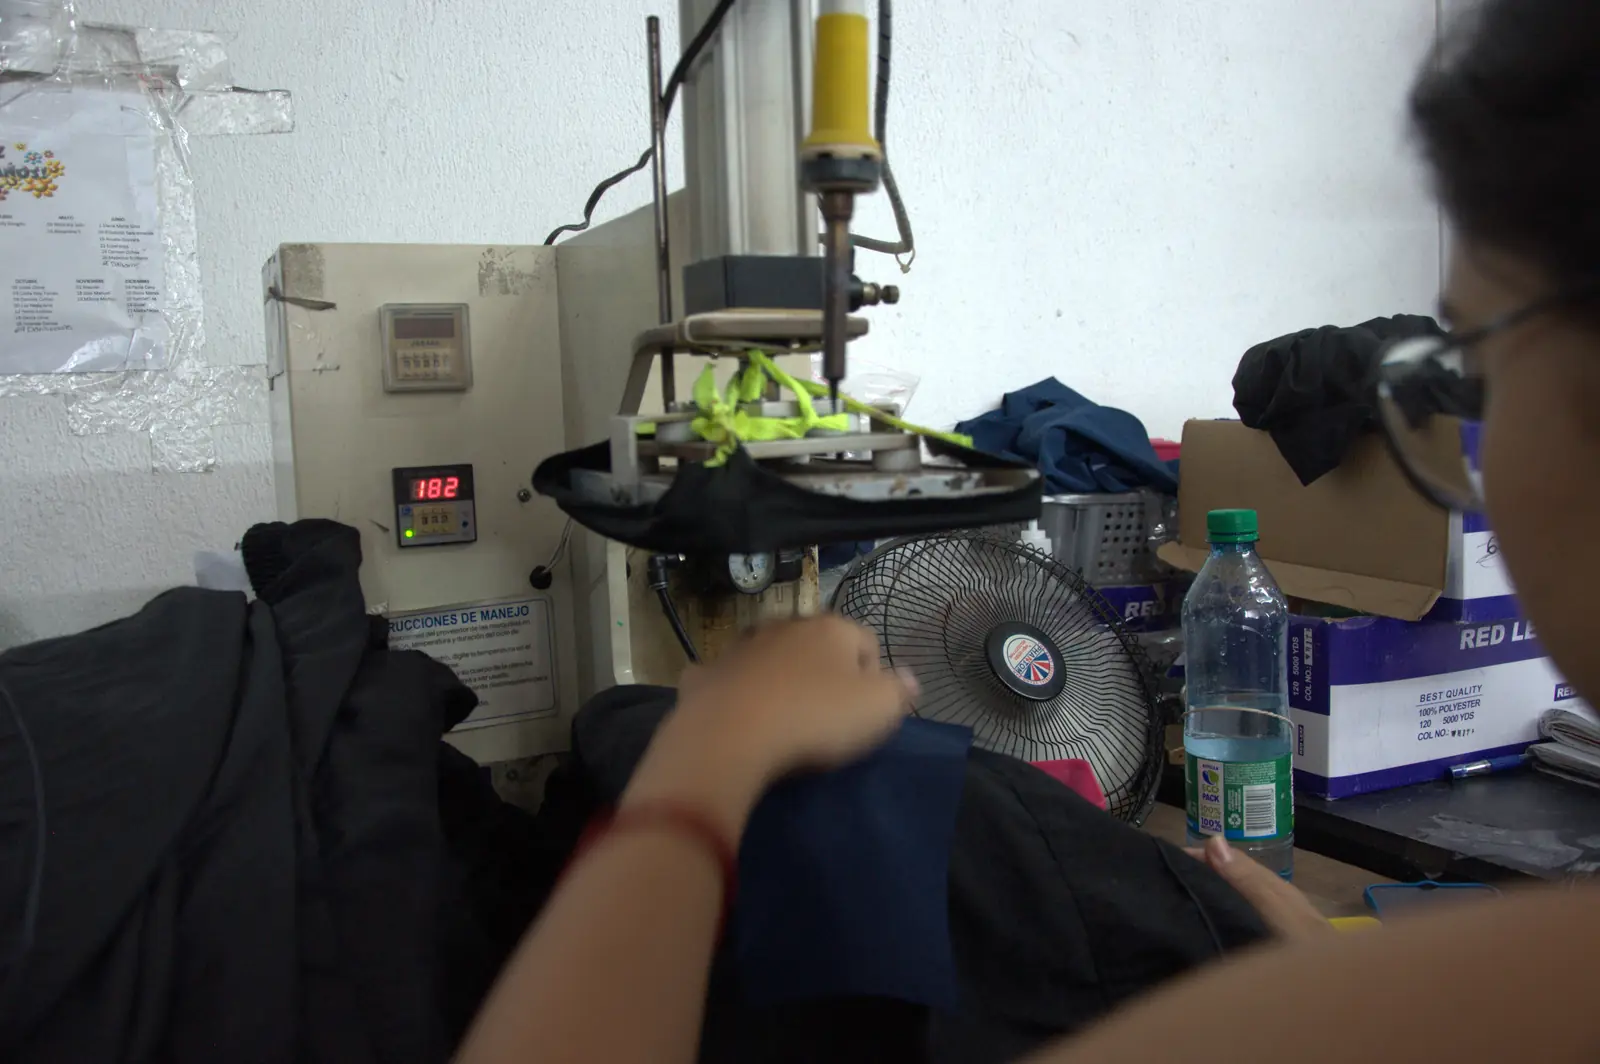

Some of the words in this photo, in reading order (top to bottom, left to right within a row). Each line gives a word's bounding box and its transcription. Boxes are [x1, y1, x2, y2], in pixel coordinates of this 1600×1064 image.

[416, 476, 459, 499] 182
[388, 614, 458, 633] RUCCIONES
[461, 612, 477, 624] DE
[480, 605, 530, 620] MANEJO
[1460, 624, 1506, 650] RED
[1016, 644, 1042, 675] PHANTOM
[1420, 692, 1443, 702] BEST
[1446, 684, 1482, 698] QUALITY
[1419, 707, 1437, 716] 100%
[1438, 699, 1480, 714] POLYESTER
[1420, 720, 1432, 728] 120
[1442, 714, 1458, 724] 5000
[1460, 712, 1474, 721] YDS
[1418, 732, 1433, 740] COL
[1202, 792, 1220, 803] PACK
[1201, 817, 1221, 828] 100%
